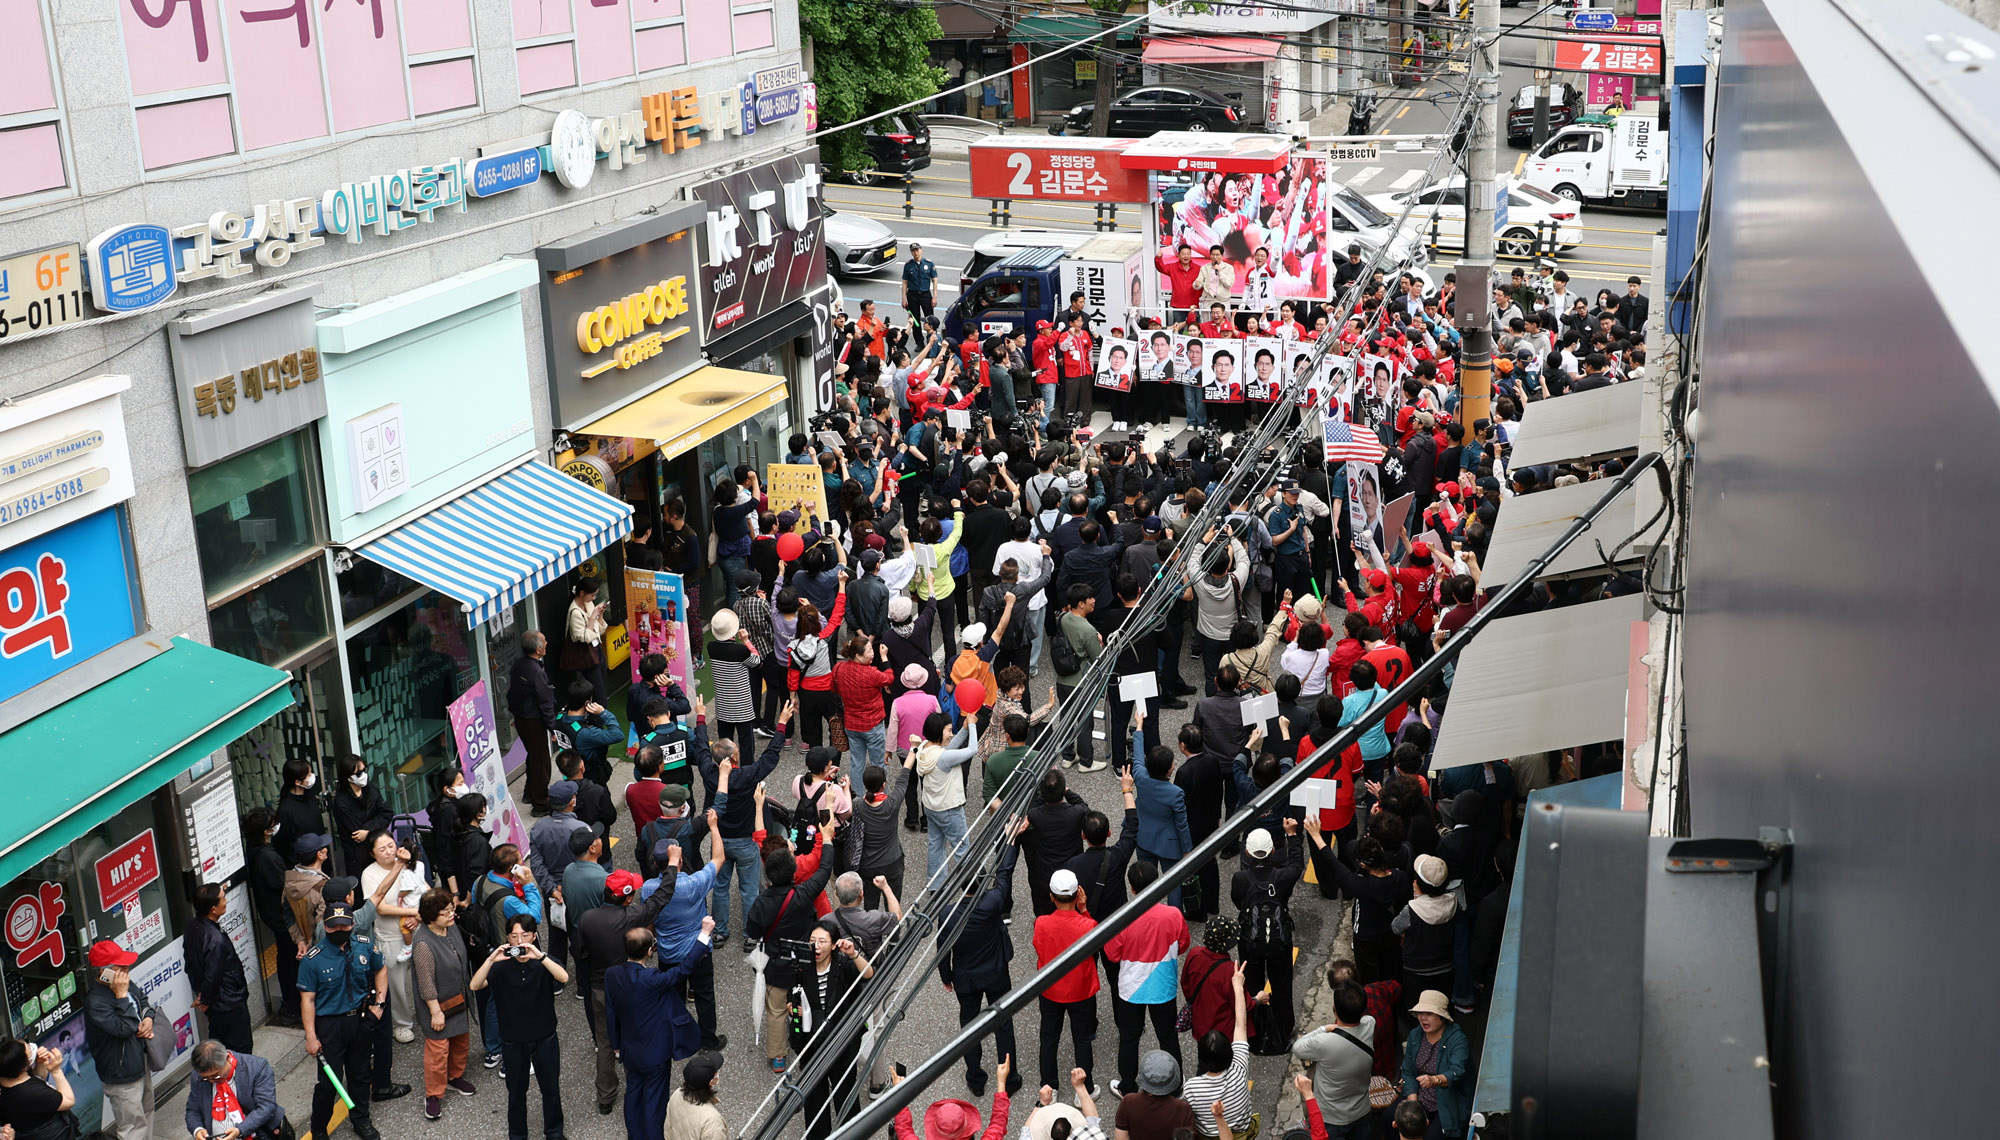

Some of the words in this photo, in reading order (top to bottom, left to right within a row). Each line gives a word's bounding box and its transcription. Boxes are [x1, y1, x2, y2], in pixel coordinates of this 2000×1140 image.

[1077, 62, 1095, 72] 임대
[1581, 43, 1601, 69] 2
[1605, 52, 1654, 70] 김문수
[763, 69, 798, 89] 건강검진센터
[745, 90, 755, 130] 의원
[1635, 121, 1650, 161] 김문수
[1050, 155, 1095, 169] 정정당당
[1190, 160, 1217, 169] 국민의힘
[1331, 149, 1376, 159] 방범용CCTV
[478, 163, 521, 189] 2655-0288
[524, 156, 536, 175] 6F
[1007, 152, 1034, 195] 2
[1040, 170, 1108, 196] 김문수
[107, 231, 160, 252] CATHOLIC
[35, 252, 70, 291] 6F
[753, 252, 775, 275] world
[713, 268, 736, 294] olleh
[112, 294, 145, 306] UNIVERSITY
[152, 282, 170, 299] KOREA
[1088, 267, 1106, 327] 김문수
[578, 275, 689, 353] COMPOSE
[614, 331, 663, 370] COFFEE
[815, 341, 831, 361] world
[1140, 339, 1149, 353] 2
[1176, 343, 1184, 357] 2
[1119, 373, 1129, 389] 2
[1141, 369, 1166, 380] 김문수
[194, 374, 237, 418] 목동
[1205, 390, 1229, 401] 김문수
[1229, 382, 1241, 400] 2
[1248, 389, 1270, 400] 김문수
[1269, 382, 1280, 400] 2
[22, 451, 53, 470] DELIGHT
[56, 436, 96, 456] PHARMACY
[665, 439, 687, 456] COMPOSE
[686, 431, 701, 446] COFFEE
[1349, 477, 1358, 503] 2
[631, 581, 650, 591] BEST
[651, 583, 676, 593] MENU
[0, 551, 72, 660] 약
[203, 769, 232, 792] INFORMATION
[110, 853, 142, 887] HIP'S
[4, 881, 66, 968] 약
[126, 913, 160, 944] 동물의약품
[140, 959, 182, 995] 티푸라민
[35, 1001, 72, 1036] 기쁨약국
